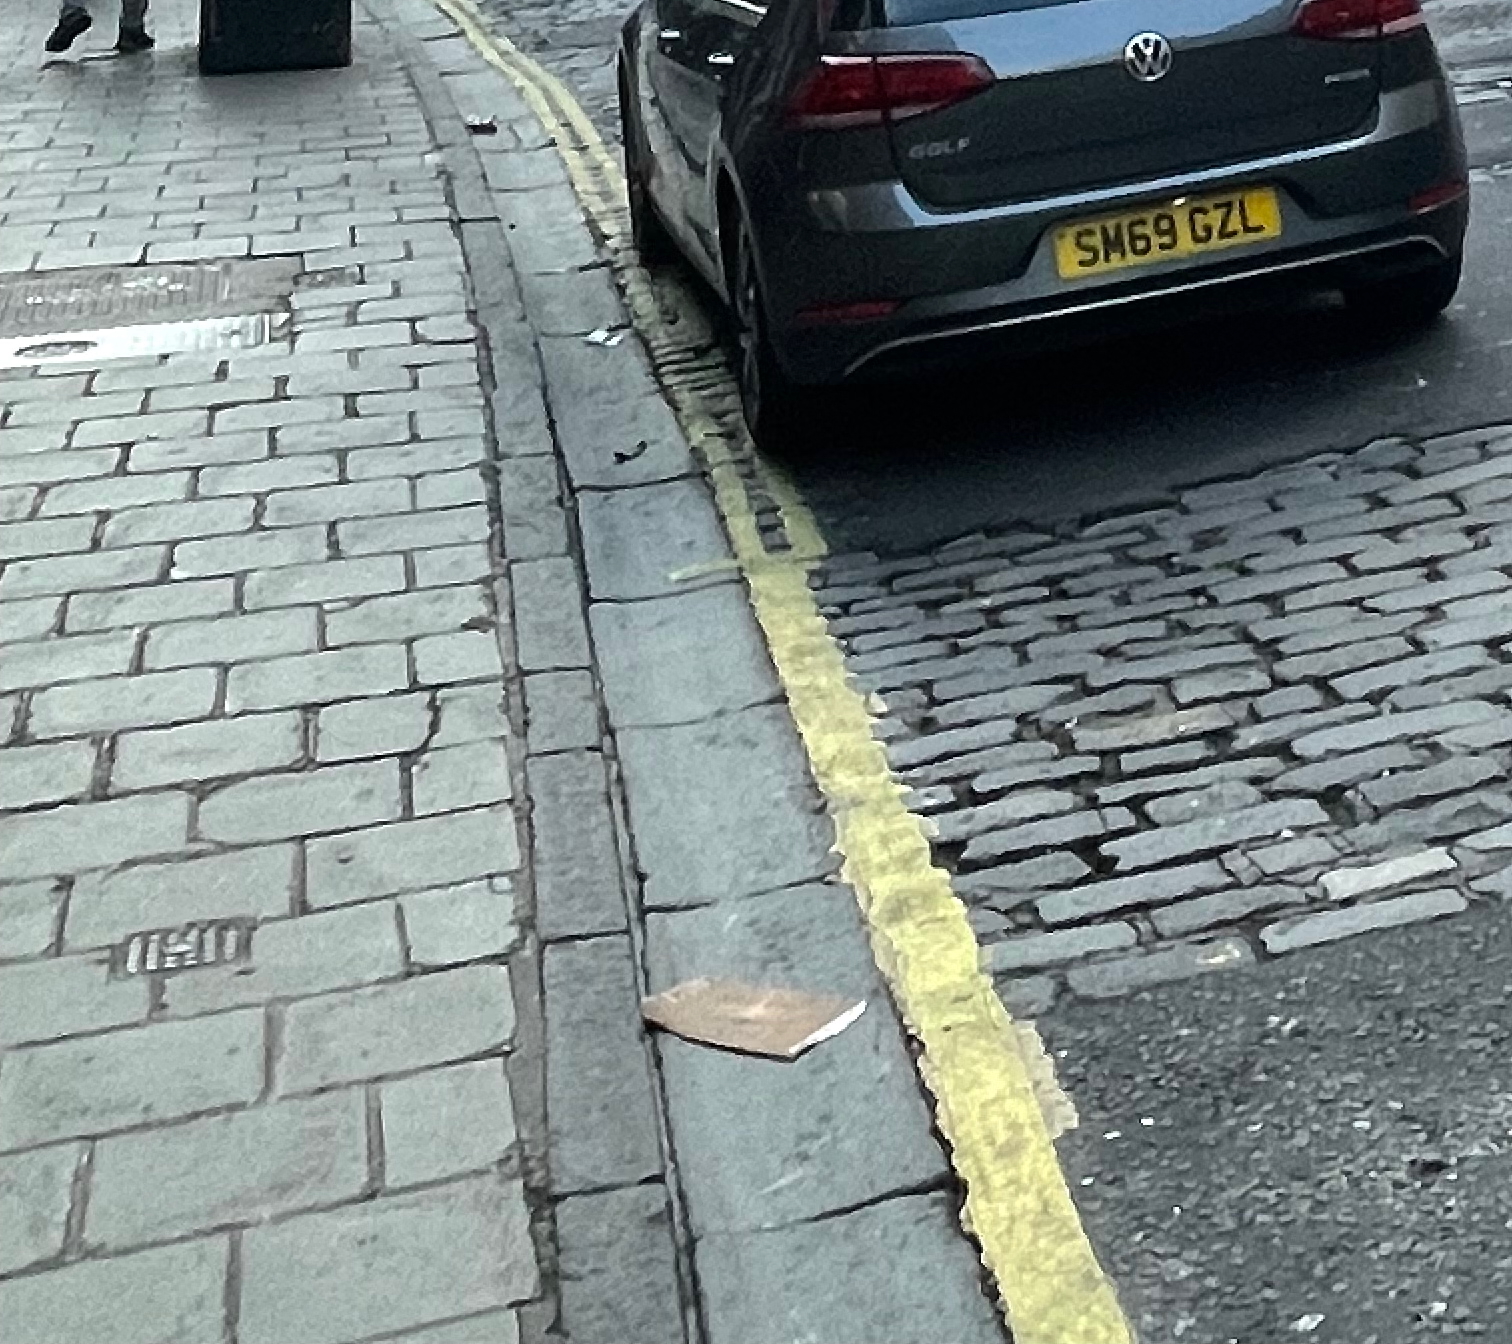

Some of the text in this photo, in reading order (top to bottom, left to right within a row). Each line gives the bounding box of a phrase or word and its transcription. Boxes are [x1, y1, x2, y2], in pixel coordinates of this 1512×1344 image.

[908, 137, 970, 160] GOLF
[1074, 197, 1266, 268] SM69 GZL
